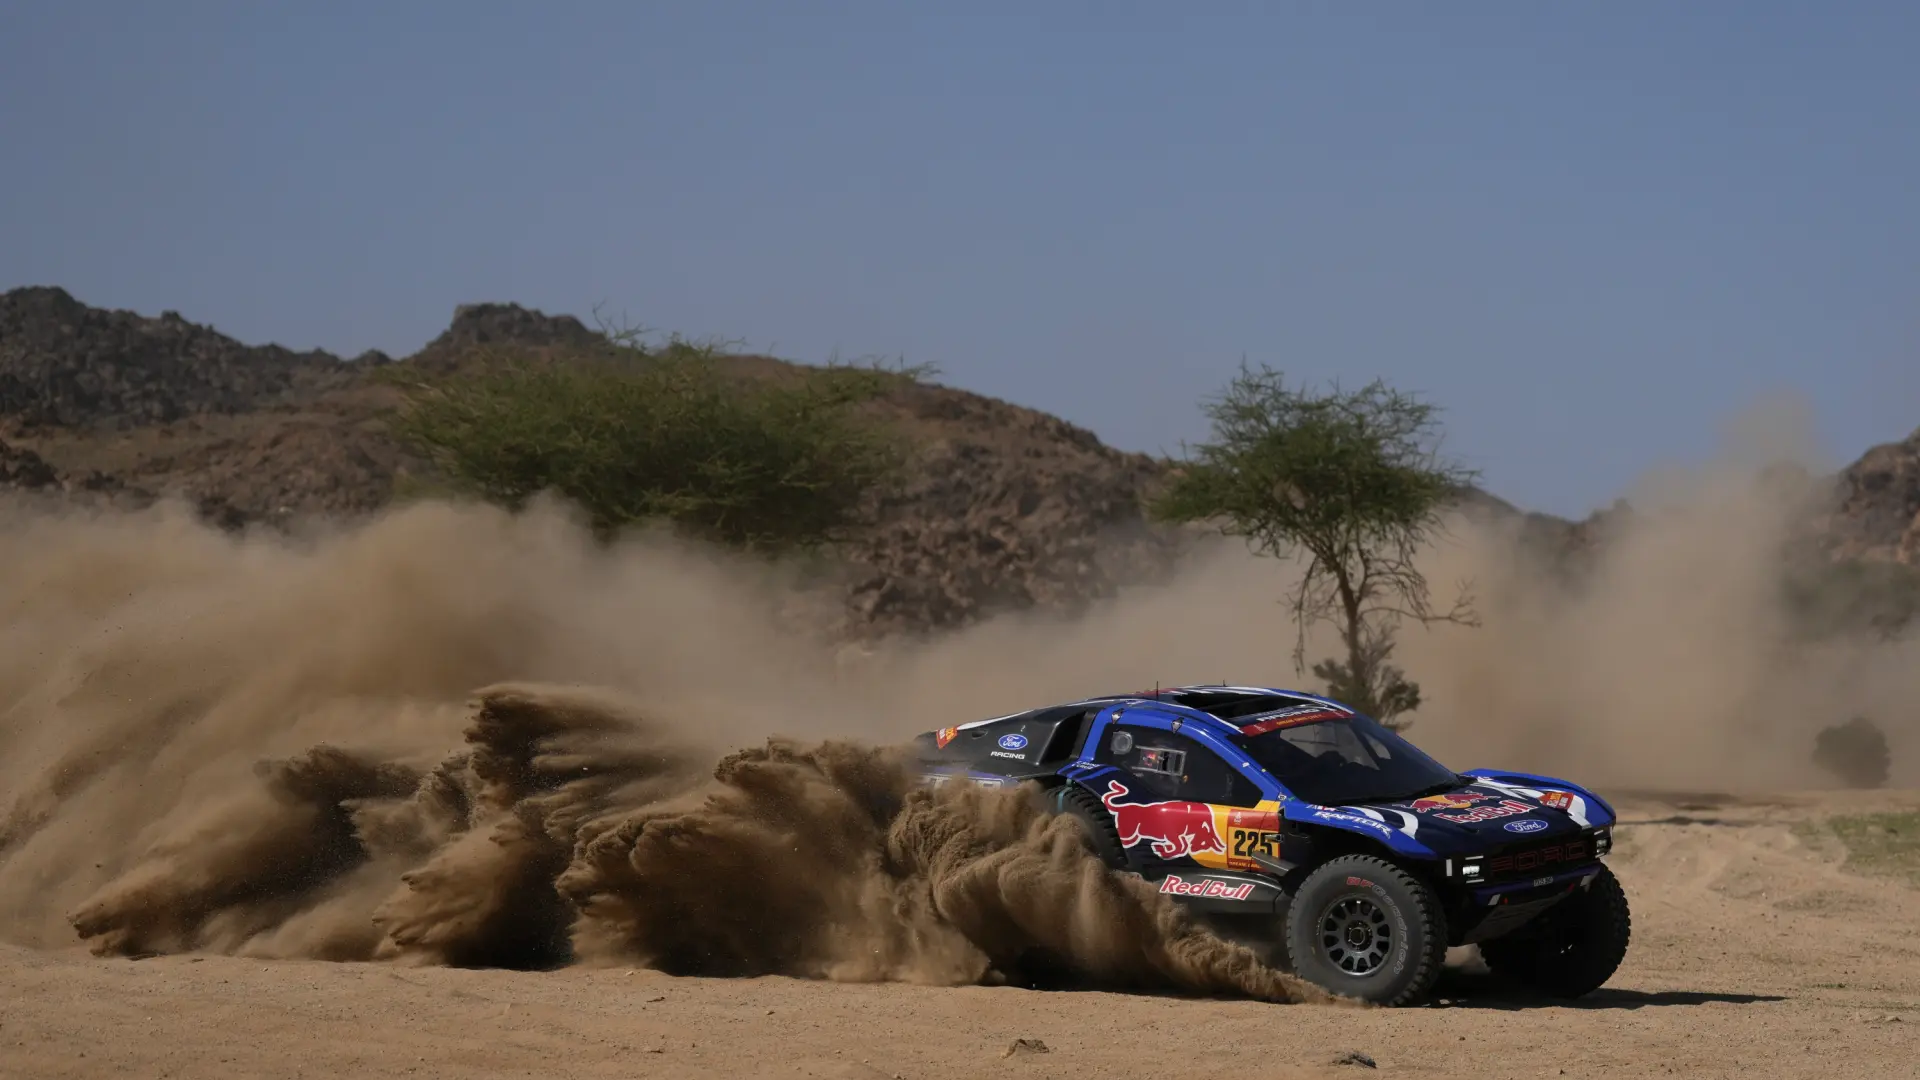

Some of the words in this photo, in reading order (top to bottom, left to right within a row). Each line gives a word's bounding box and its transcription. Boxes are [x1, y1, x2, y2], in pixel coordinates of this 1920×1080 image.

[990, 751, 1025, 760] RACING
[1313, 811, 1393, 839] RAPTOR
[1234, 830, 1273, 857] 225
